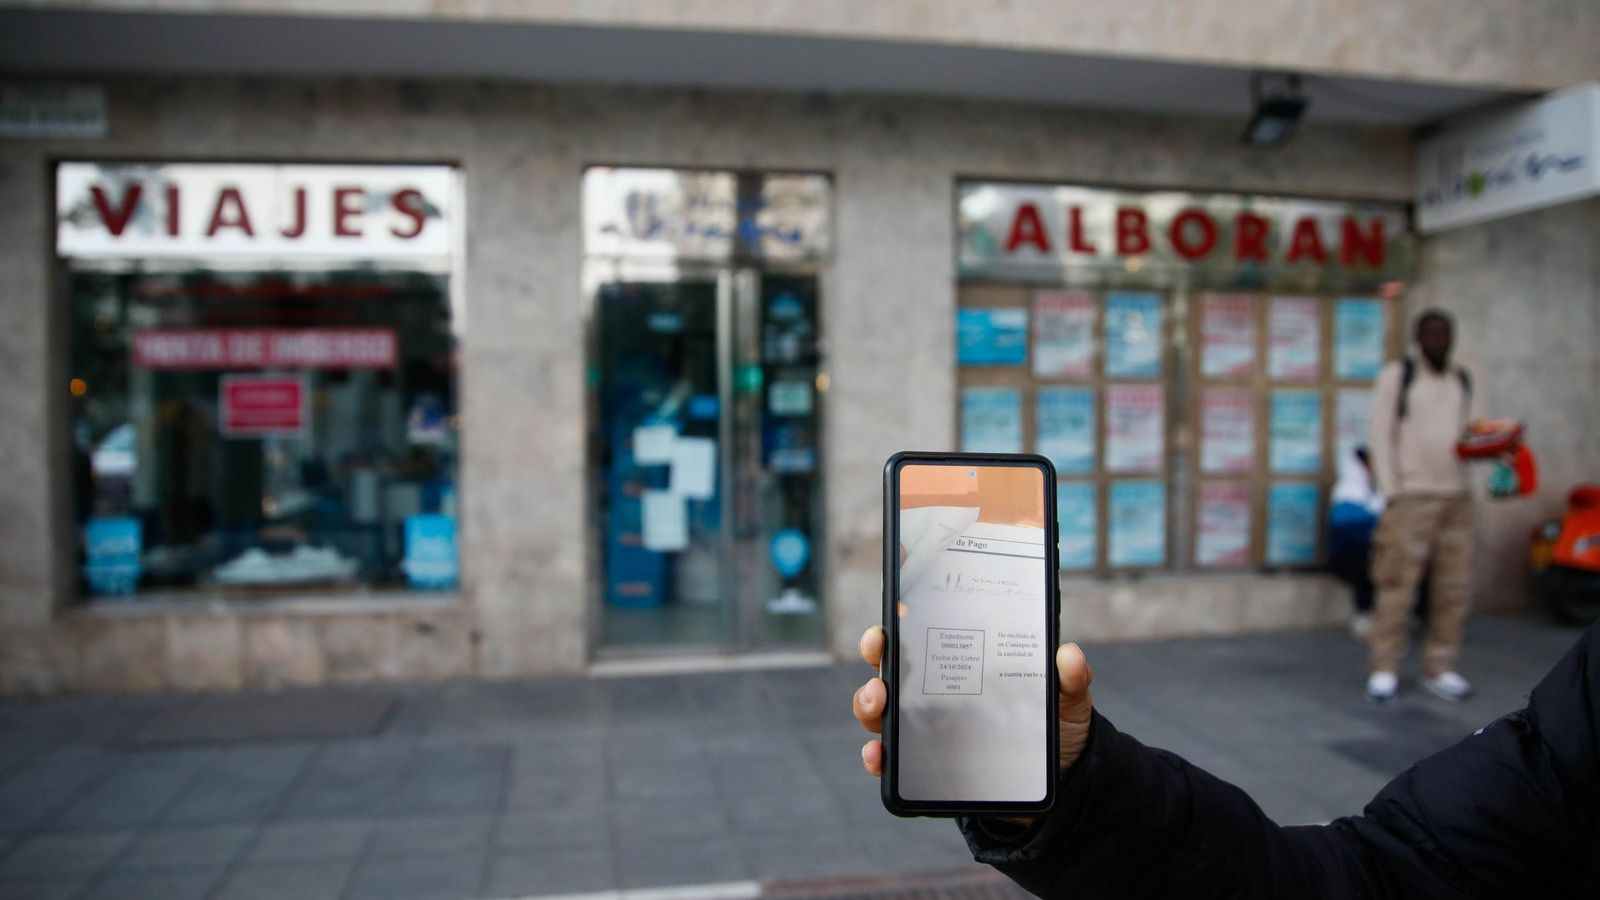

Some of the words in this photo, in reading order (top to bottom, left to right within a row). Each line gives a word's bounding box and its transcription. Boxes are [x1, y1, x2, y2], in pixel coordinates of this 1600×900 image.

[90, 184, 428, 239] VIAJES
[1004, 202, 1386, 268] ALBORAN
[956, 538, 966, 547] de
[968, 539, 988, 549] Pago
[971, 576, 1019, 586] VIAJES
[940, 632, 975, 641] Expediente
[941, 673, 968, 682] Pasajero
